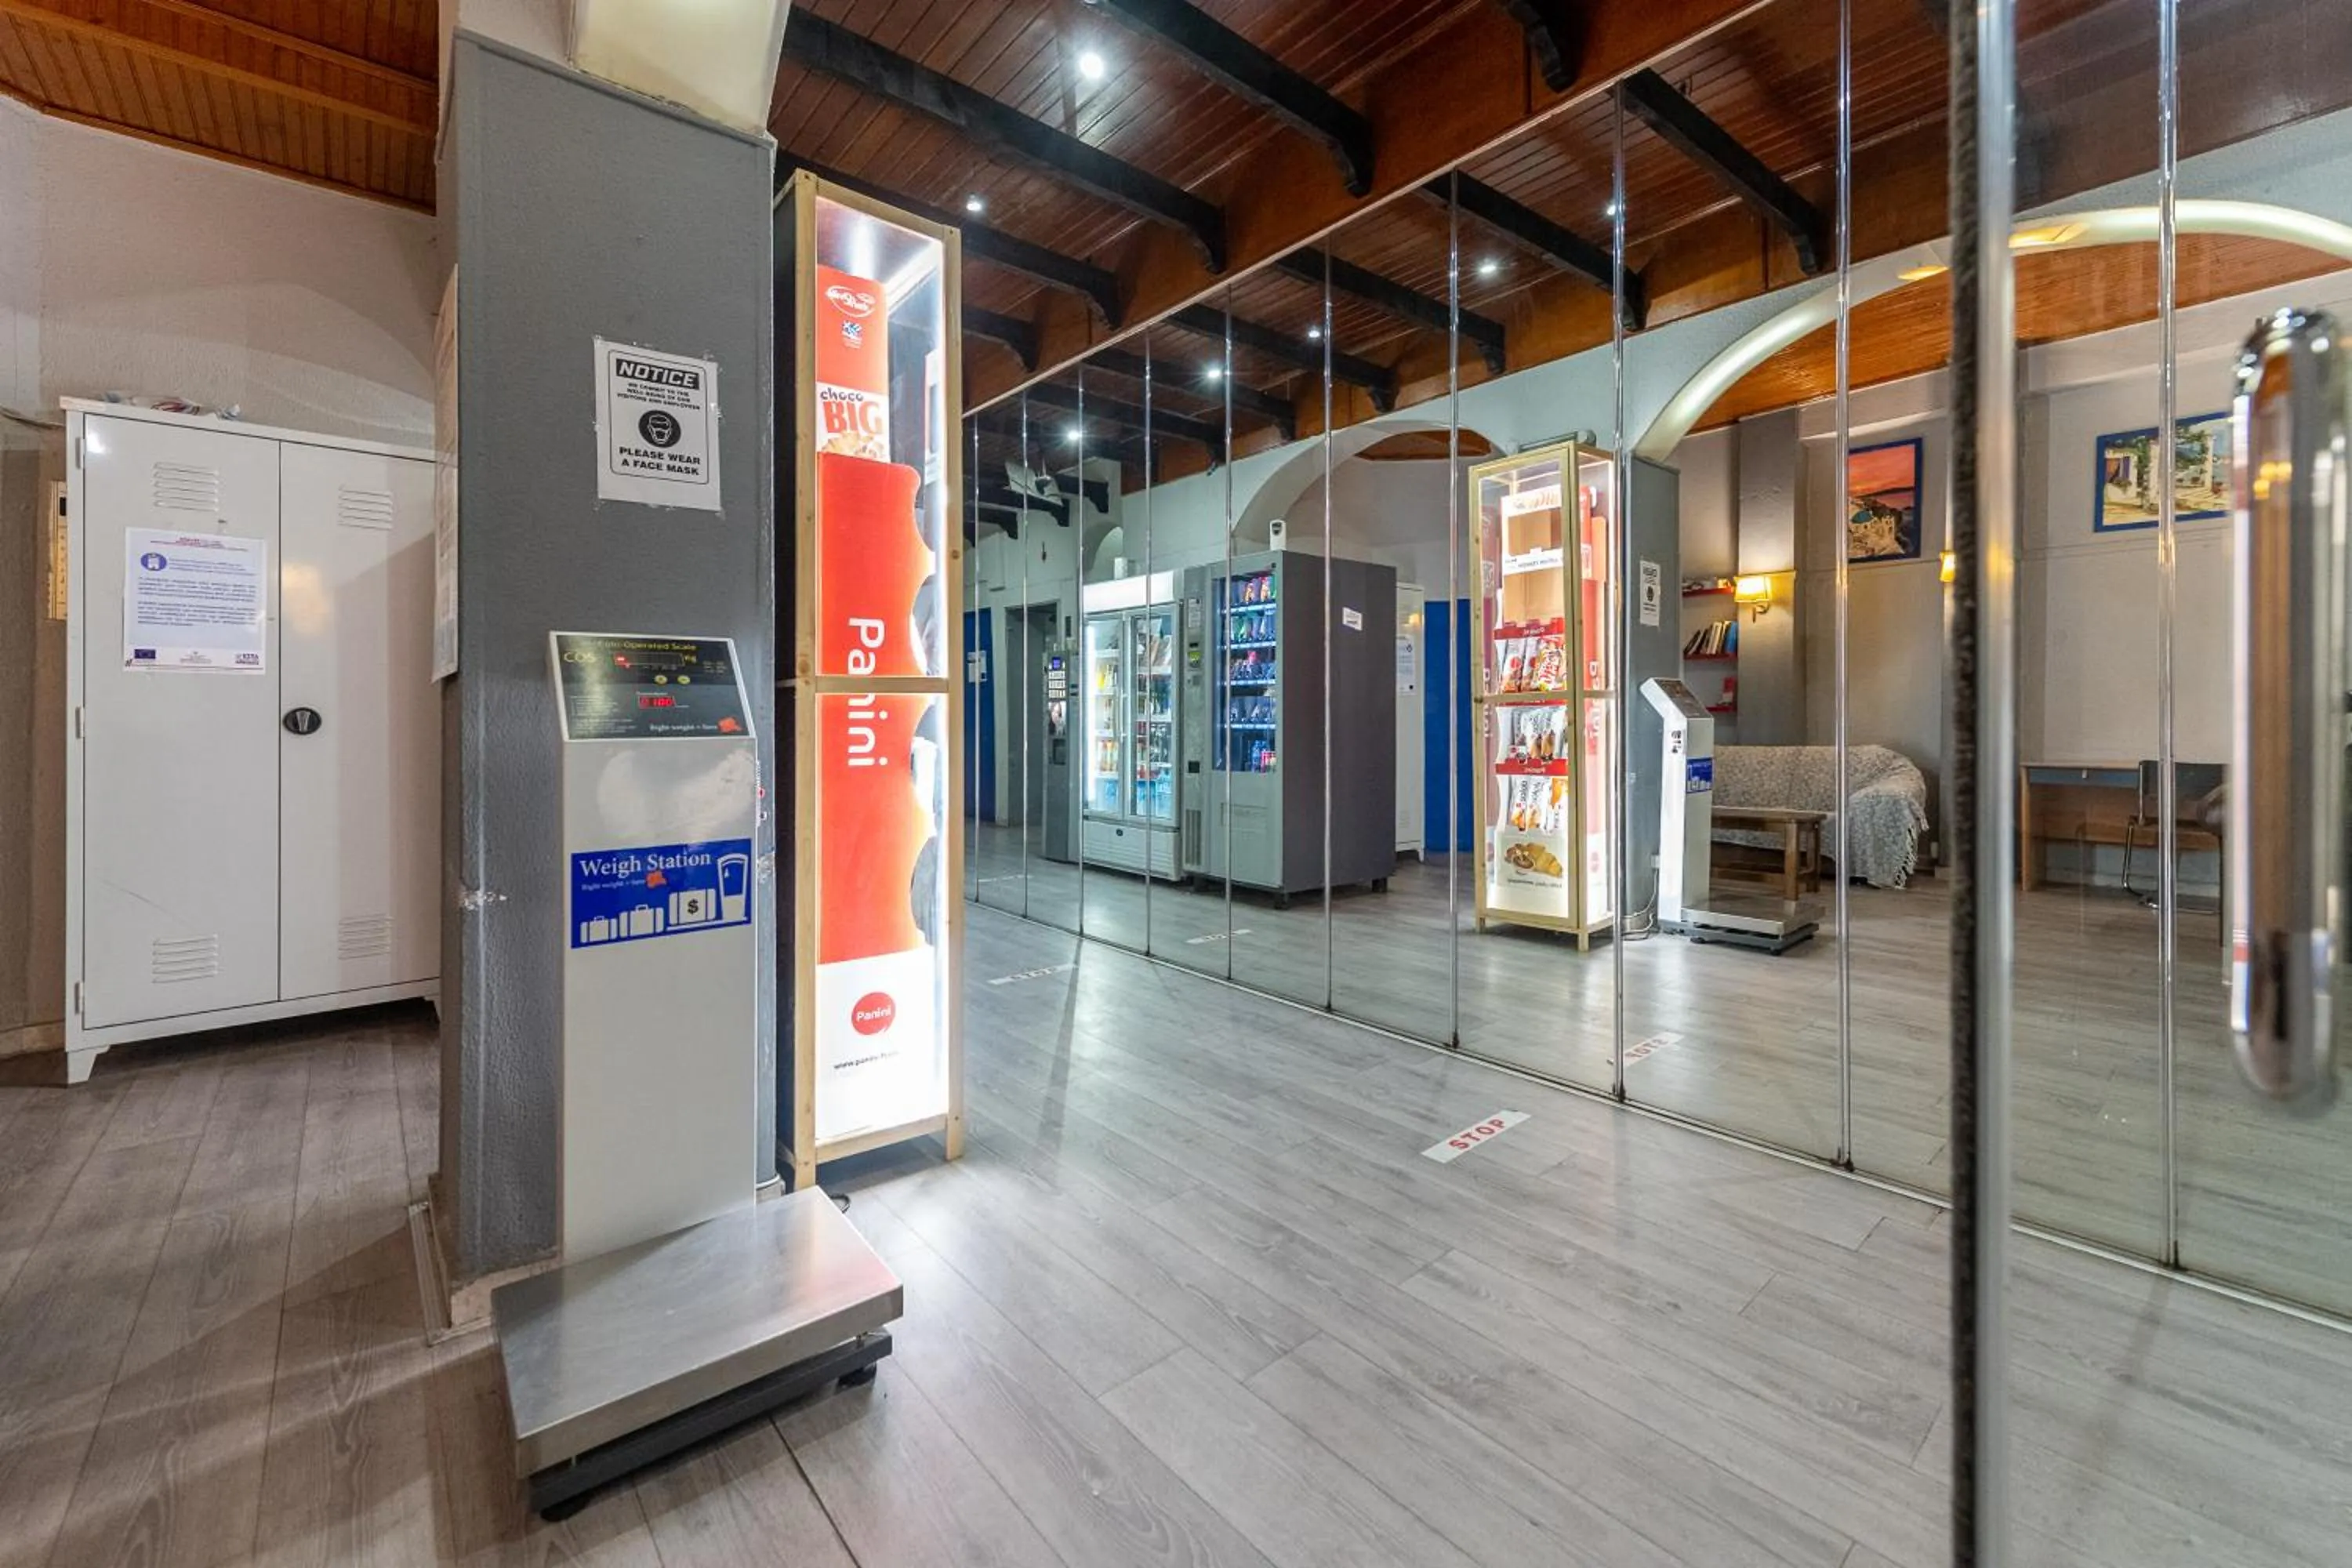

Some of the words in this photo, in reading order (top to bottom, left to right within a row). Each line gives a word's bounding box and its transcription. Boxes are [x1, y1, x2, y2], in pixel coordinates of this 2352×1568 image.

[619, 361, 696, 387] NOTICE
[820, 387, 864, 402] choco
[822, 401, 883, 434] BIG
[619, 446, 665, 460] PLEASE
[667, 454, 701, 465] WEAR
[621, 459, 630, 467] A
[633, 460, 665, 470] FACE
[666, 464, 700, 476] MASK
[579, 855, 641, 879] Weigh
[647, 852, 711, 871] Station
[856, 1005, 892, 1022] Panini
[1449, 1119, 1505, 1150] STOP
